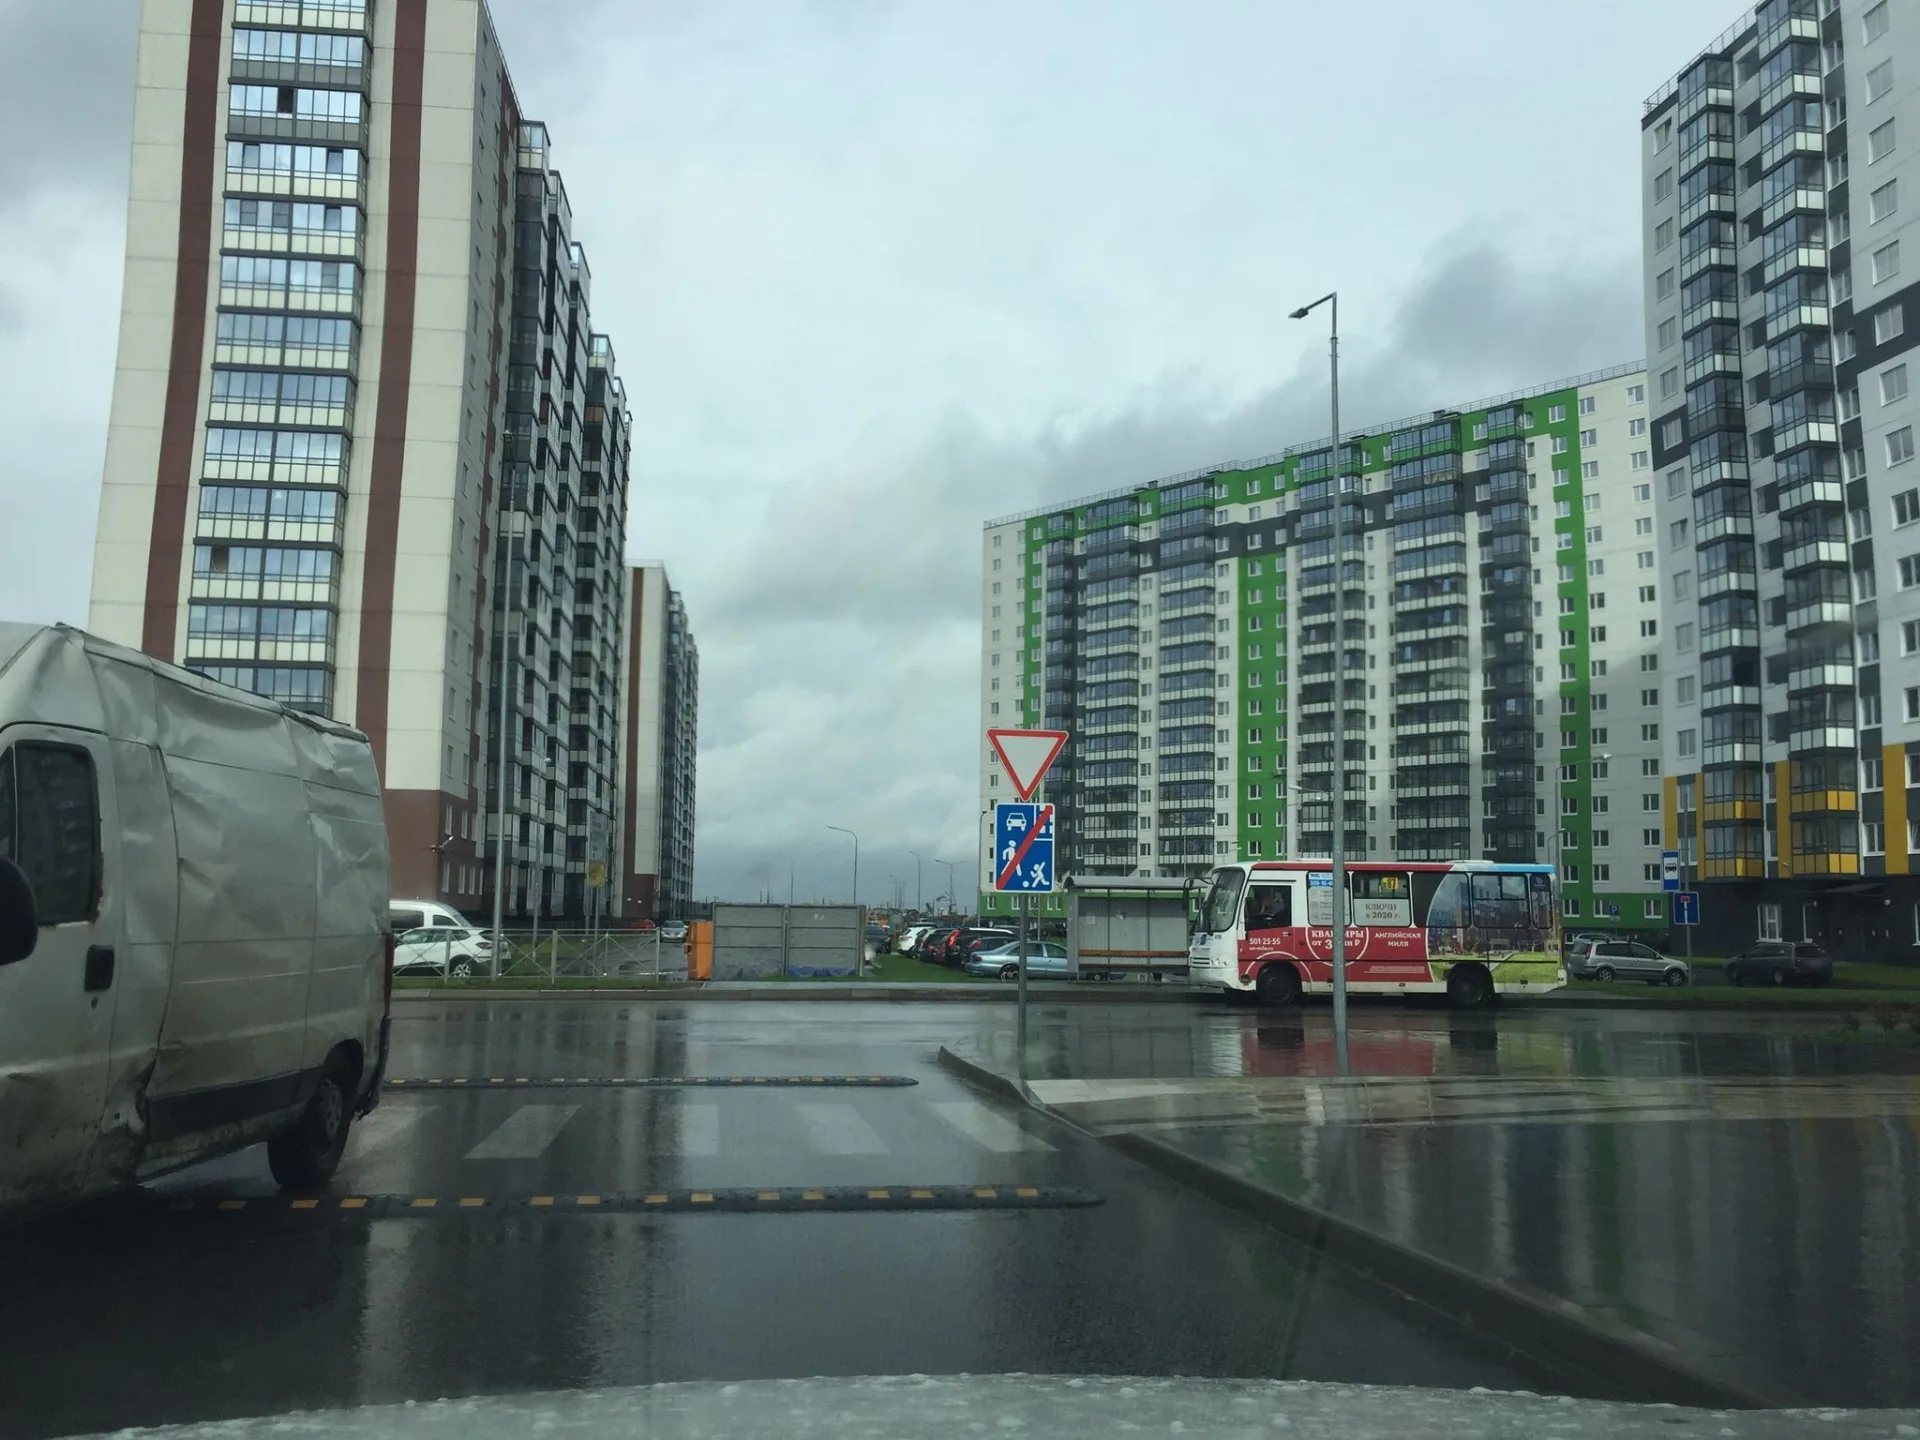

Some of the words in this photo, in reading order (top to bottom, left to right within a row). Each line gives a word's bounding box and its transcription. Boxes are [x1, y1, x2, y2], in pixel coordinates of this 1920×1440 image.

[1365, 903, 1397, 911] КЛЮЧИ
[1372, 911, 1393, 919] 2020
[1374, 931, 1421, 939] АНГЛИЙСКАЯ
[1249, 937, 1281, 945] 501-25-55
